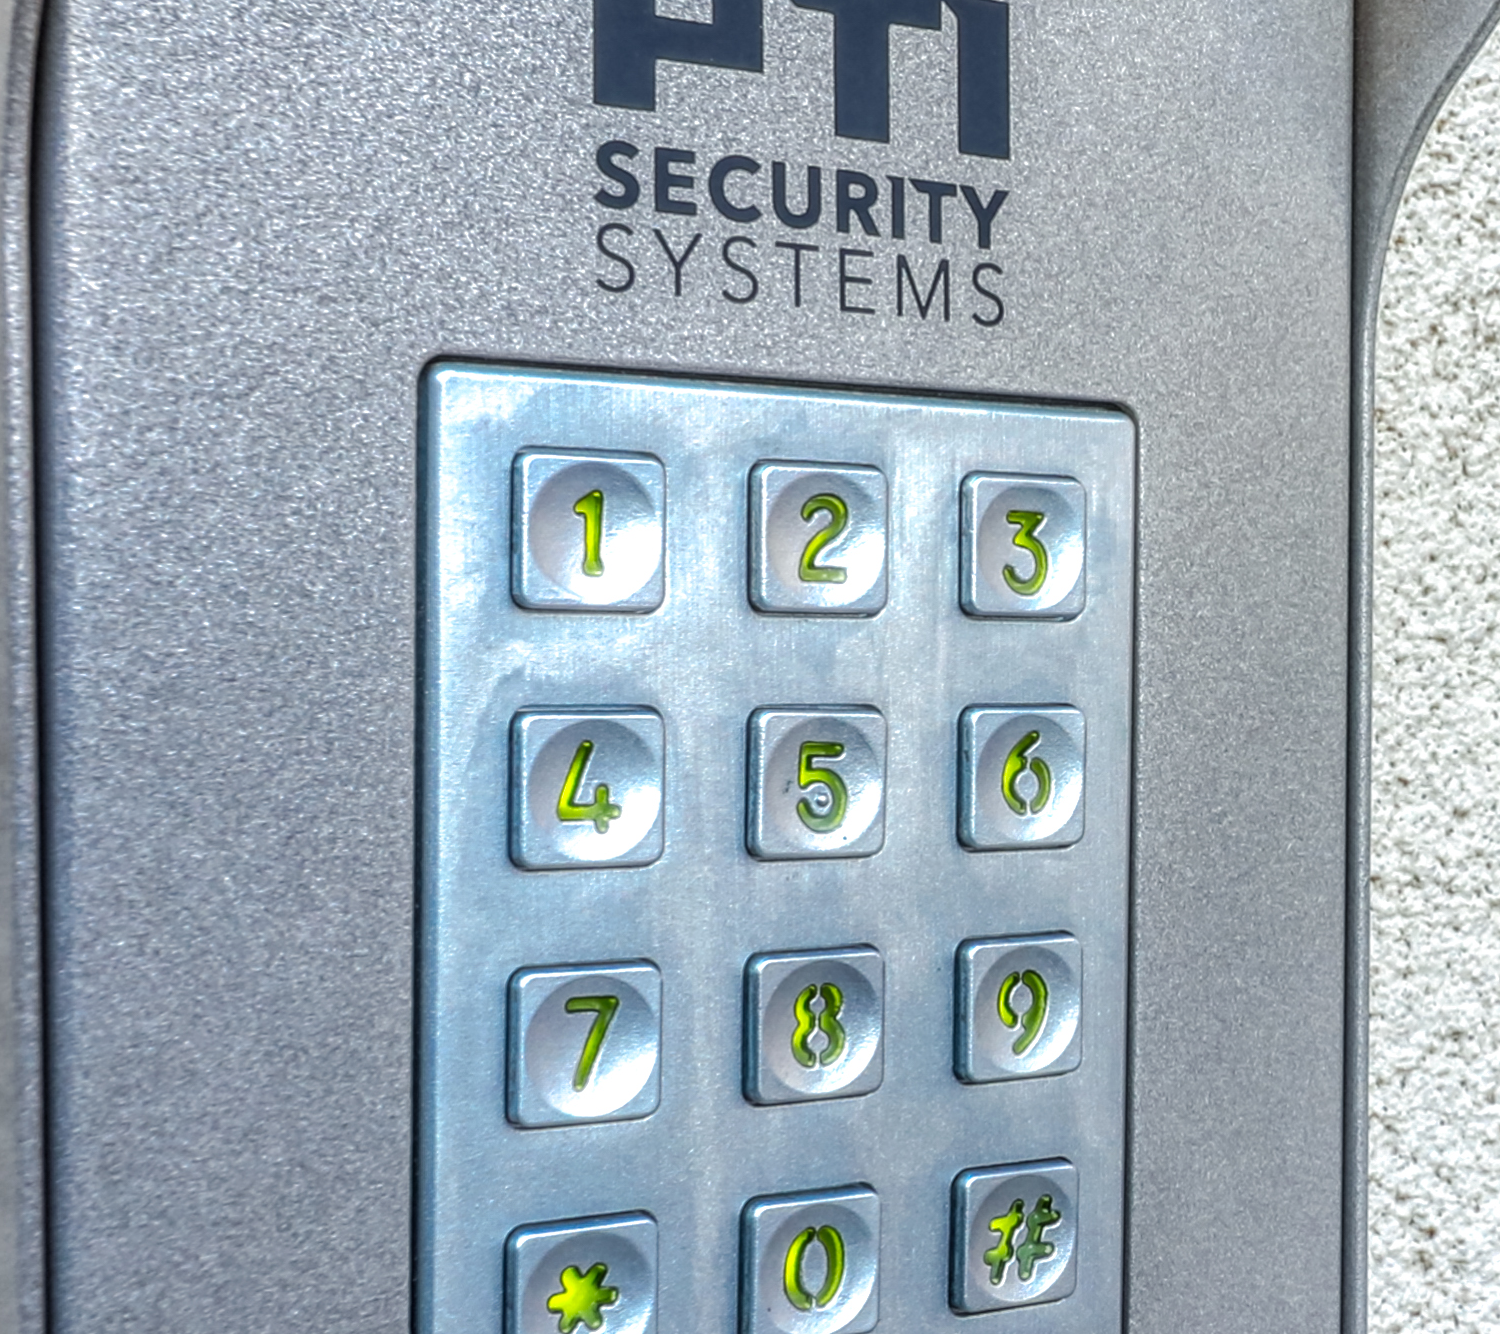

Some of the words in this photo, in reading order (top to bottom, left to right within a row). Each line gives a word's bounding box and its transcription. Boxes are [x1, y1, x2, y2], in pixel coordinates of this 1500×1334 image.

[593, 139, 1009, 251] SECURITY
[596, 222, 1006, 328] SYSTEMS
[573, 489, 604, 577] 1
[798, 493, 849, 584] 2
[1002, 509, 1049, 596] 3
[556, 739, 622, 835] 4
[796, 740, 848, 833] 5
[1001, 730, 1052, 817] 6
[565, 995, 620, 1093] 7
[791, 982, 846, 1069] 8
[997, 969, 1050, 1056] 9
[783, 1225, 846, 1312] 0
